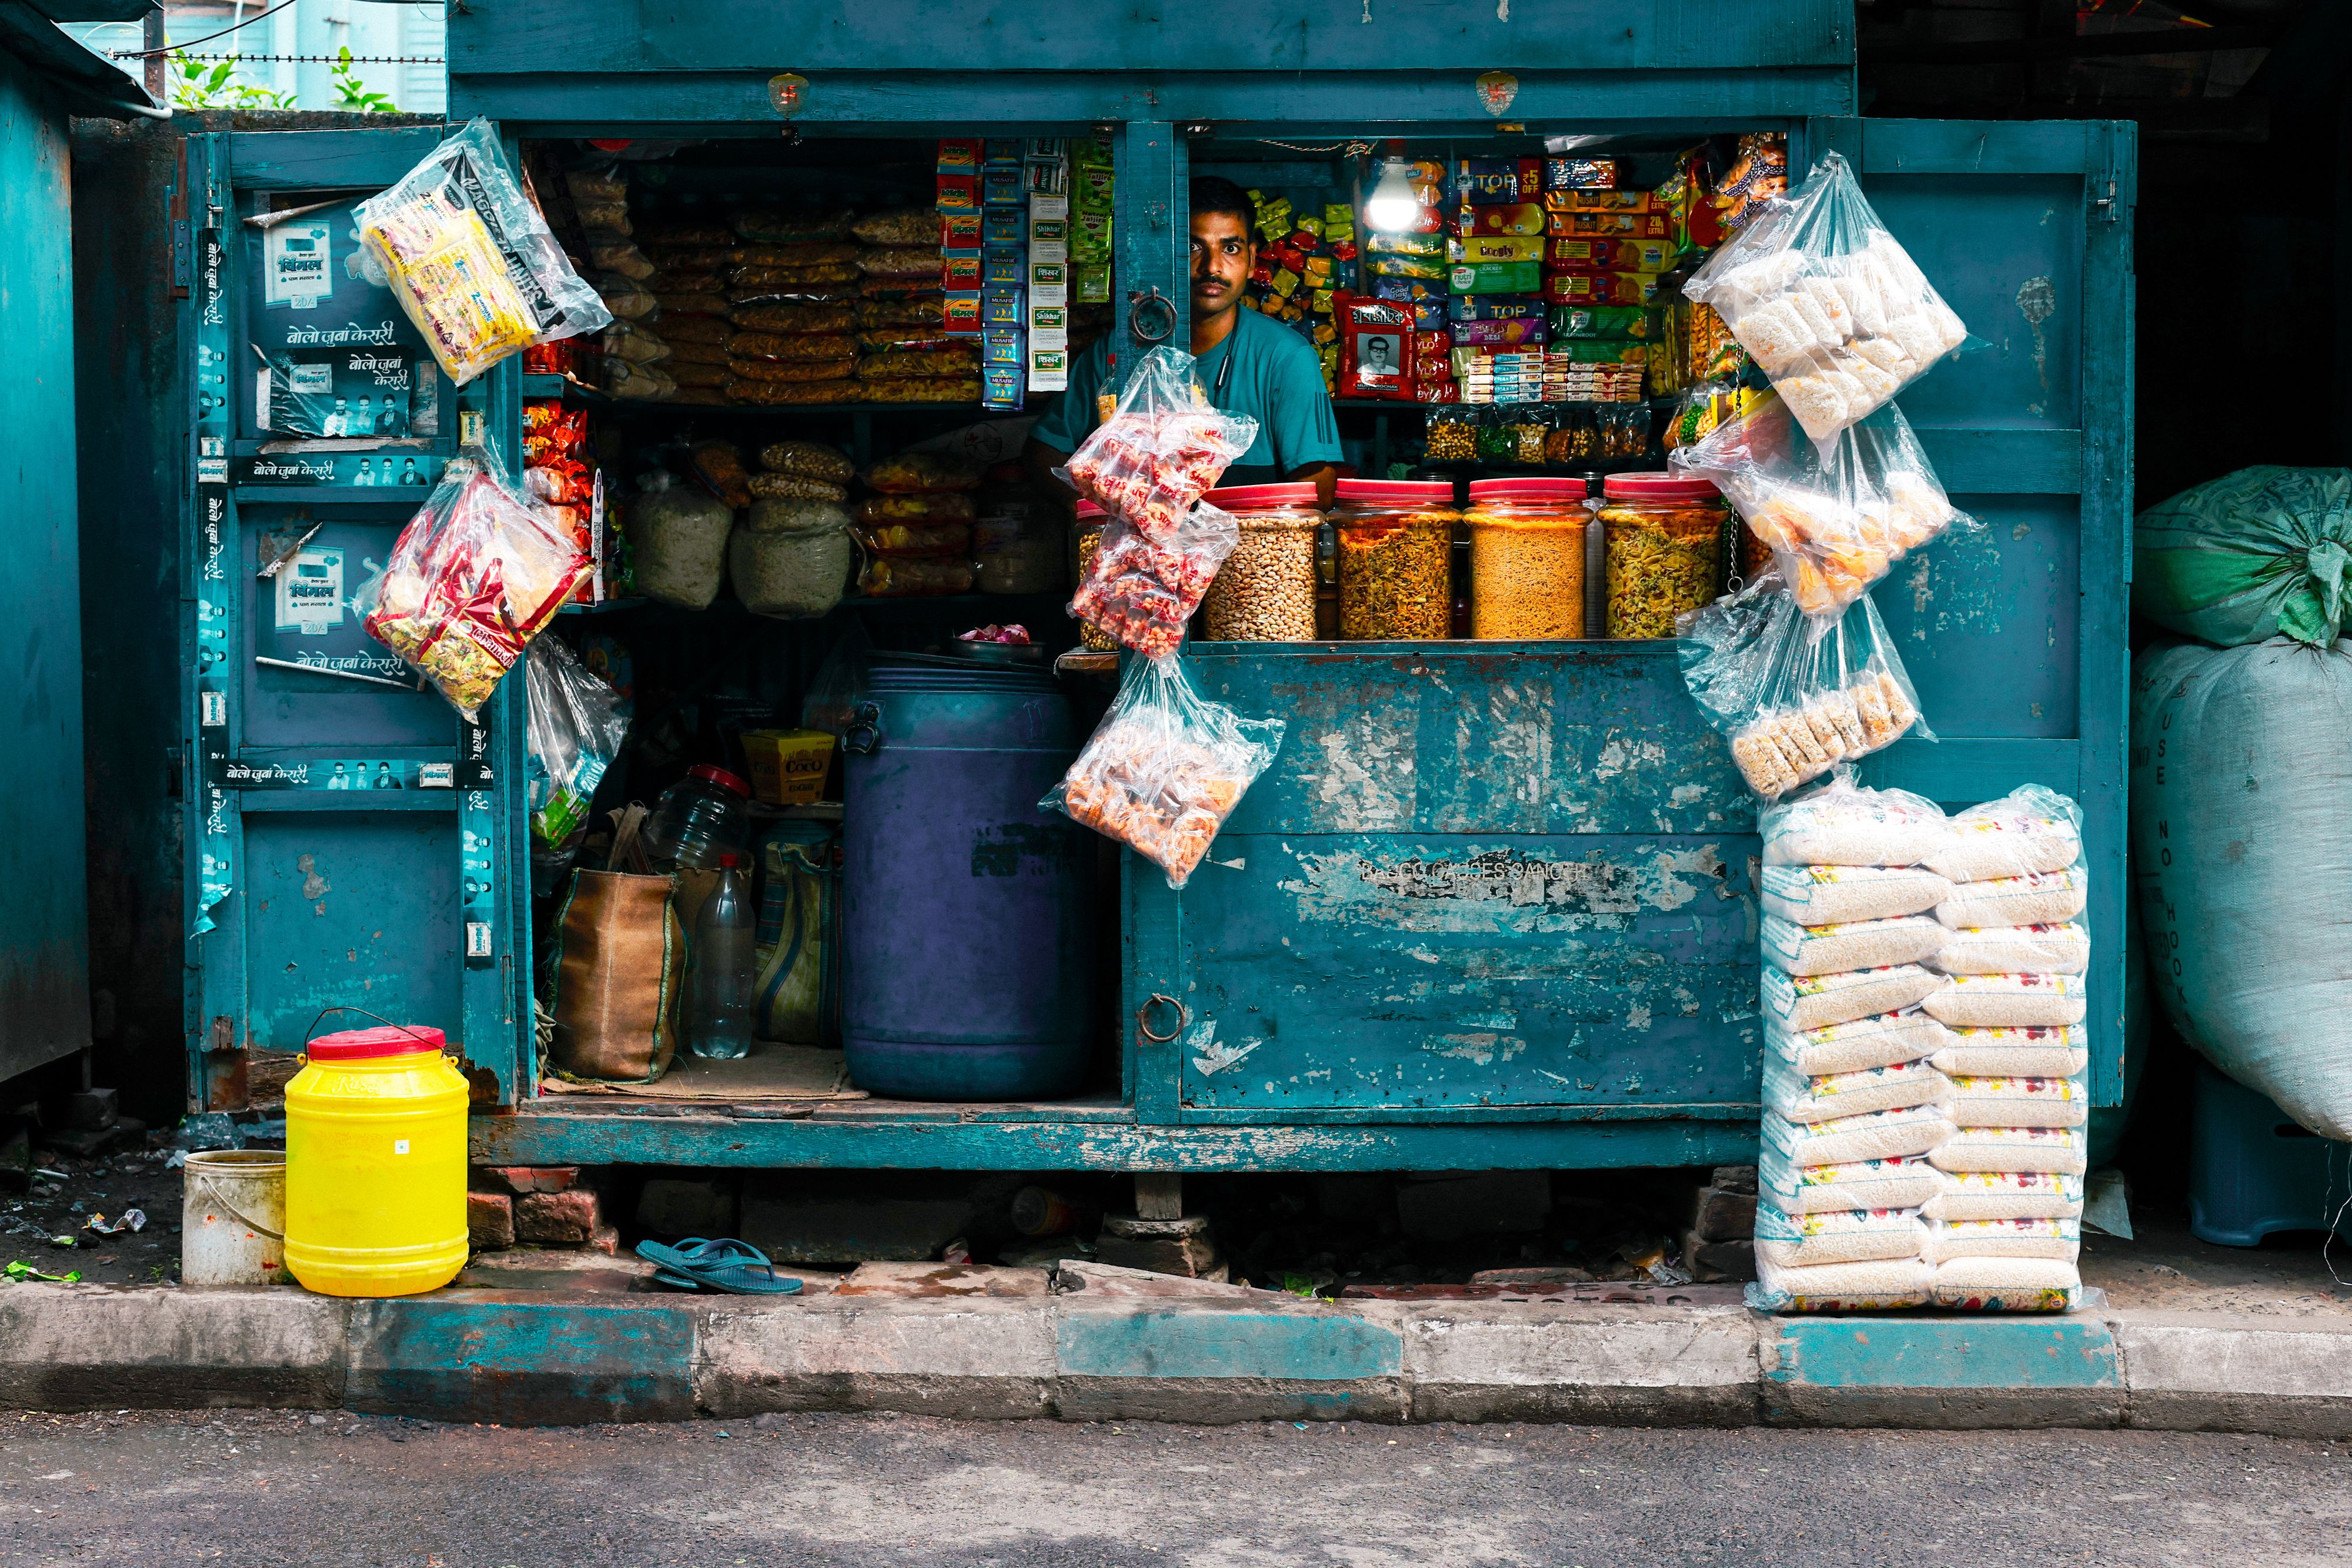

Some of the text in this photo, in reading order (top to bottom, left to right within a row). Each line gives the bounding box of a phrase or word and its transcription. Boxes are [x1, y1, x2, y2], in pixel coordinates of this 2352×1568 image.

[444, 185, 463, 209] Maggi
[1522, 185, 1539, 194] OFF
[1578, 196, 1599, 205] RUSKIT
[1081, 210, 1107, 218] Natraj
[1649, 216, 1663, 228] 20g
[1575, 220, 1596, 229] RUSKIT
[208, 242, 221, 267] बोलो
[278, 255, 325, 274] विमल
[1038, 268, 1059, 276] शिखर
[1389, 286, 1409, 294] Good
[1392, 292, 1408, 301] Day
[204, 289, 223, 326] केसरी
[1490, 305, 1527, 318] TOP
[286, 325, 321, 344] बोलो
[348, 320, 397, 346] केसरी
[1416, 341, 1435, 350] YLO
[349, 353, 378, 370] बोलो
[373, 369, 410, 391] केसरी
[253, 462, 279, 476] बोलो
[299, 460, 335, 480] केसरी
[209, 497, 223, 521] बोलो
[204, 544, 224, 580] केसरी
[288, 579, 337, 599] विमल
[296, 651, 329, 668] बोलो
[473, 728, 487, 754] बोलो
[226, 764, 251, 779] बोलो
[273, 764, 309, 784] केसरी
[207, 799, 227, 835] केसरी
